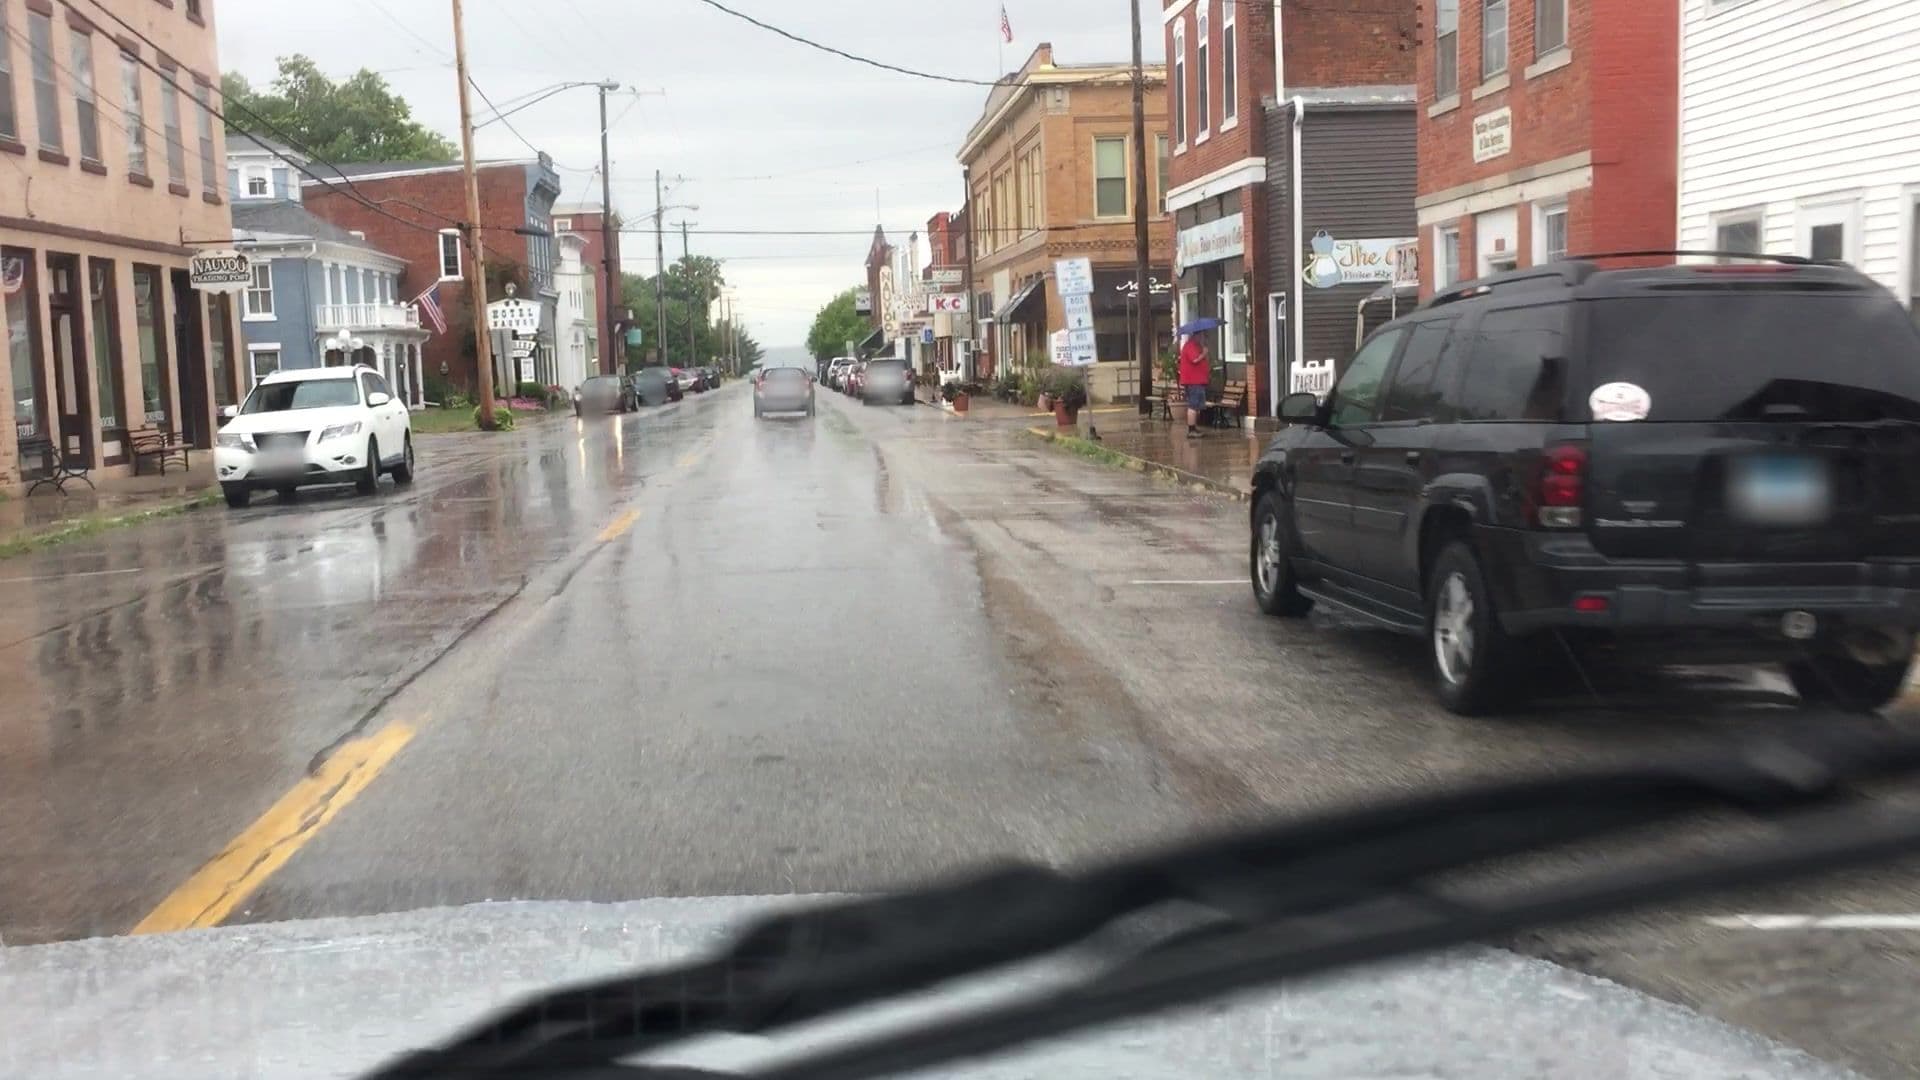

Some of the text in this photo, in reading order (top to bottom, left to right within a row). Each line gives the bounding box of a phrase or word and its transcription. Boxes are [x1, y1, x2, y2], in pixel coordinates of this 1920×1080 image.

[1336, 241, 1381, 267] The
[193, 257, 247, 274] NAUVOO
[192, 273, 250, 282] TRADING POST
[492, 308, 534, 319] HOTEL
[1295, 373, 1329, 392] PAGEANT
